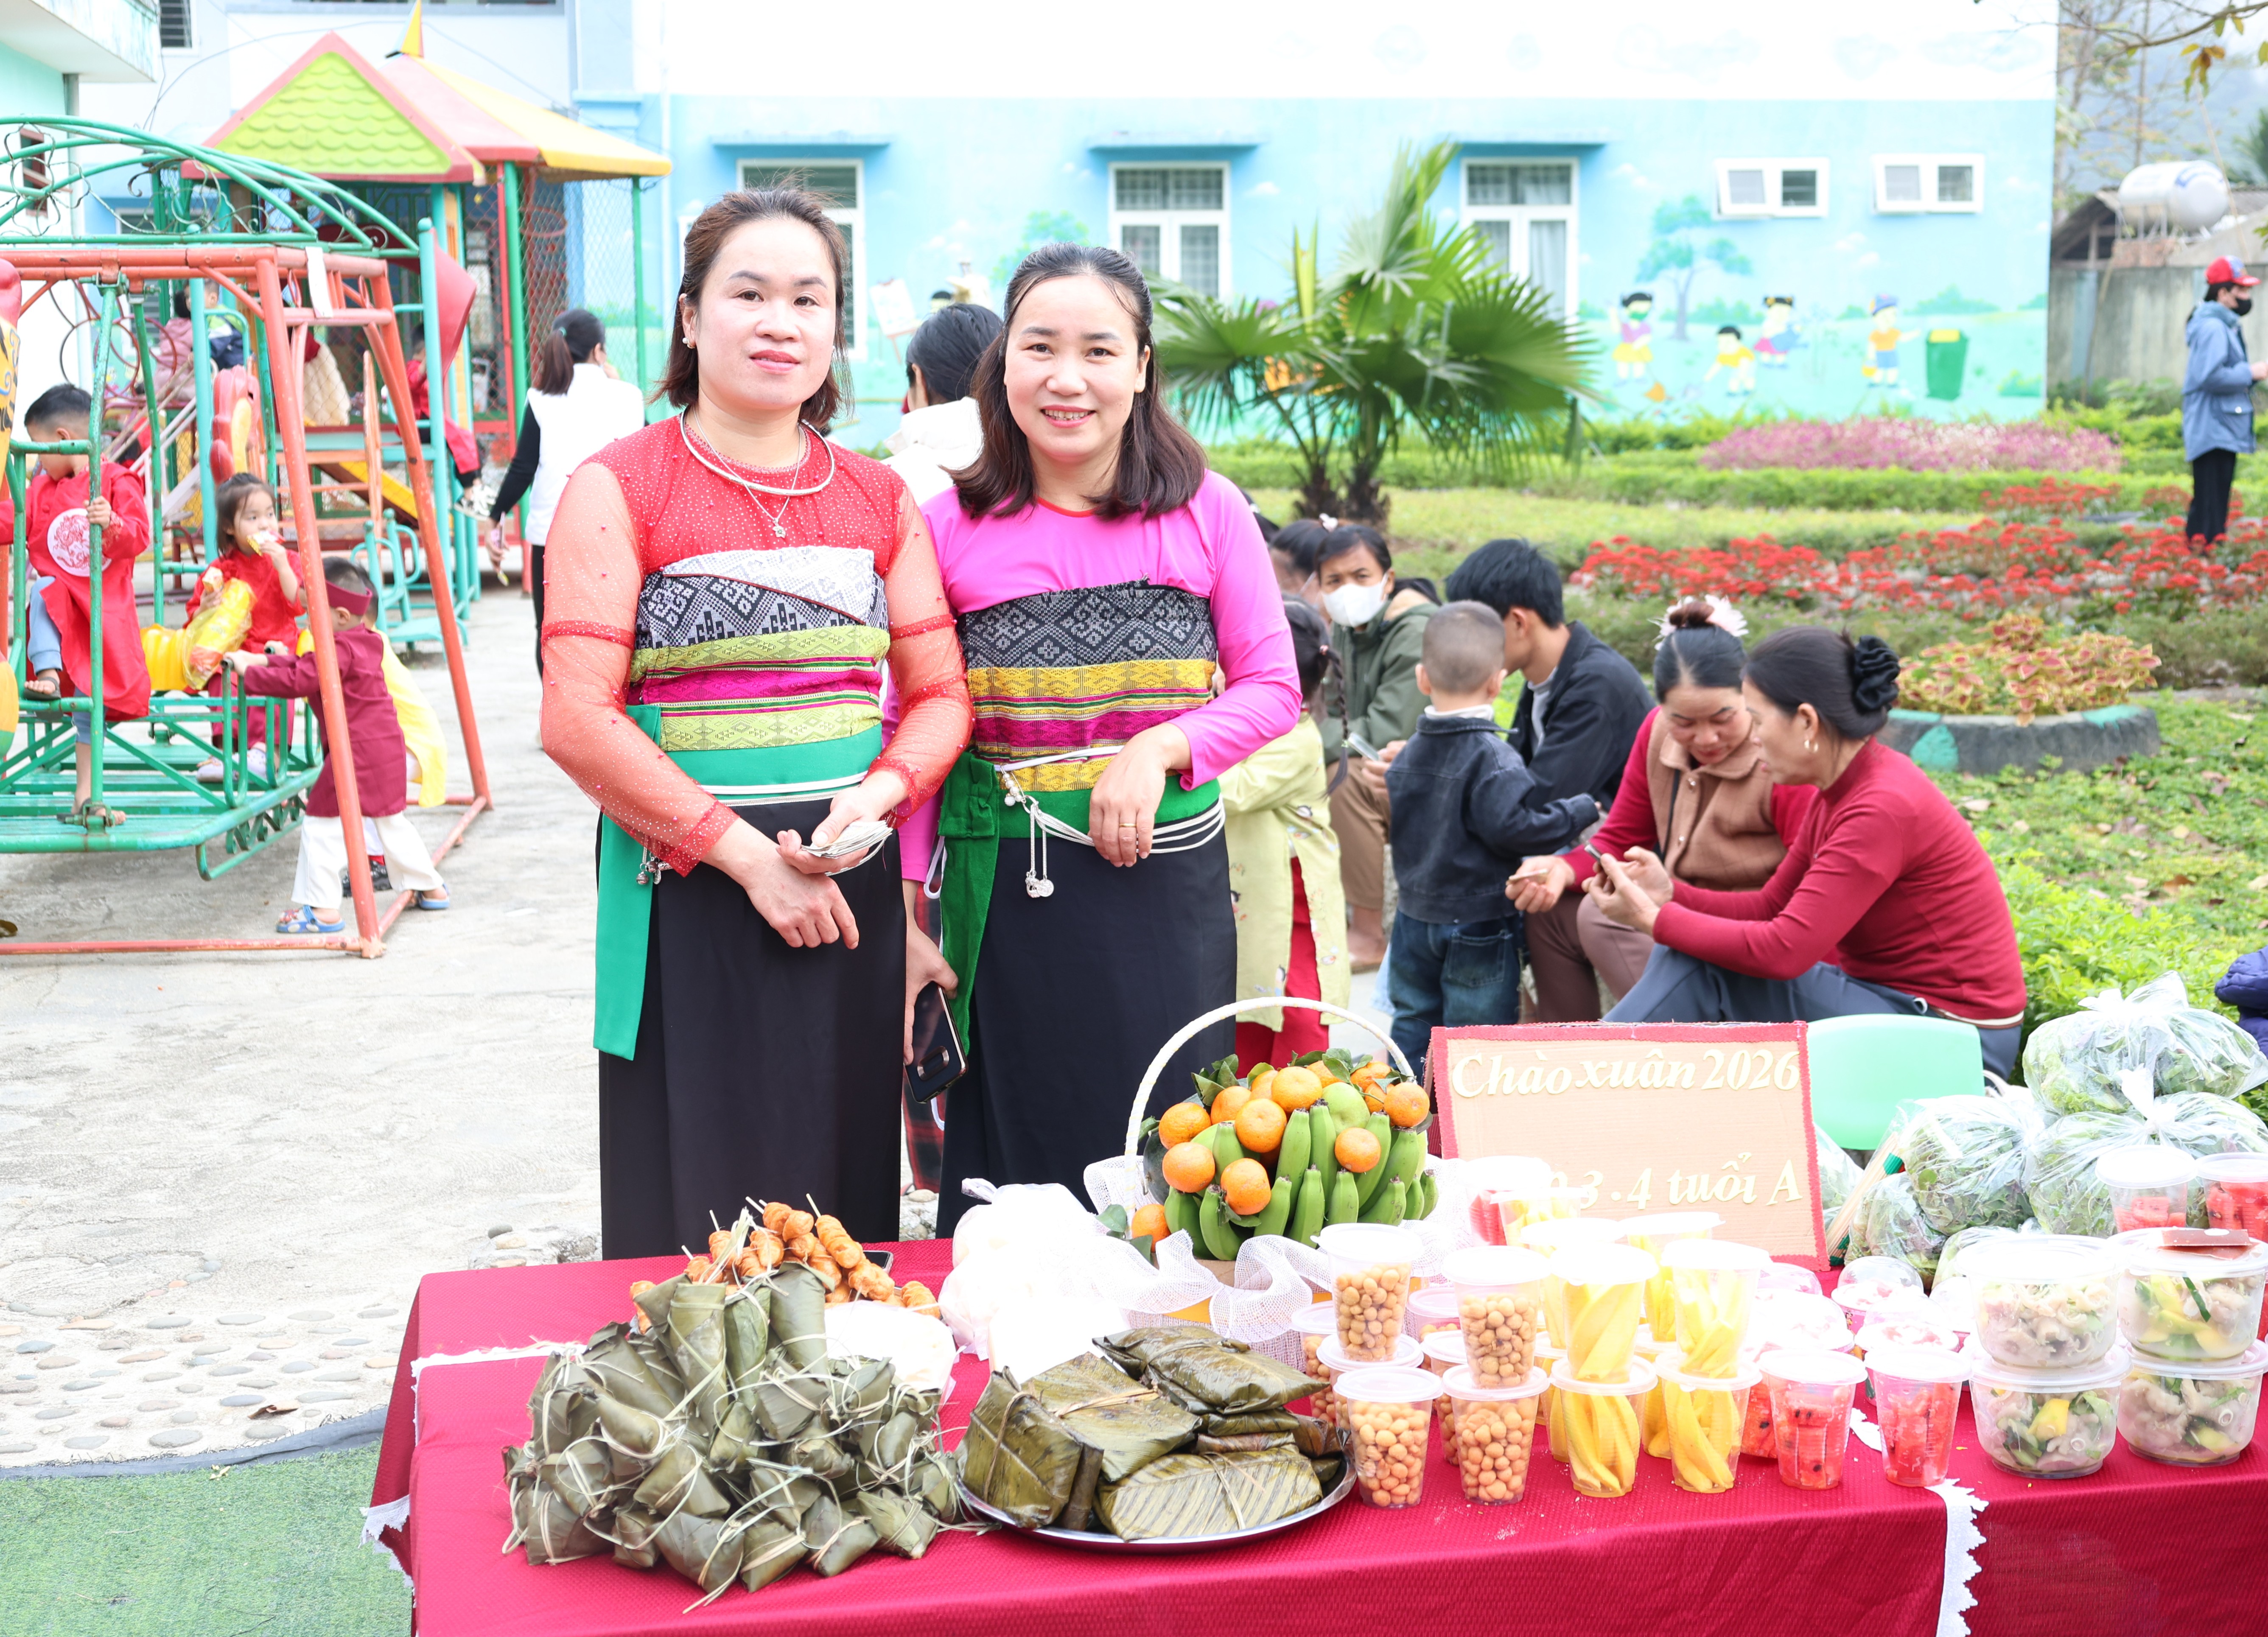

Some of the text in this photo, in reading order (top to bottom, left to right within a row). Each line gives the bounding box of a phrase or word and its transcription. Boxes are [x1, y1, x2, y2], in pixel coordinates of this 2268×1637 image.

[1452, 1048, 1800, 1098] Chào xuân 2026
[1667, 1152, 1758, 1205] tuổi
[1766, 1159, 1803, 1206] A
